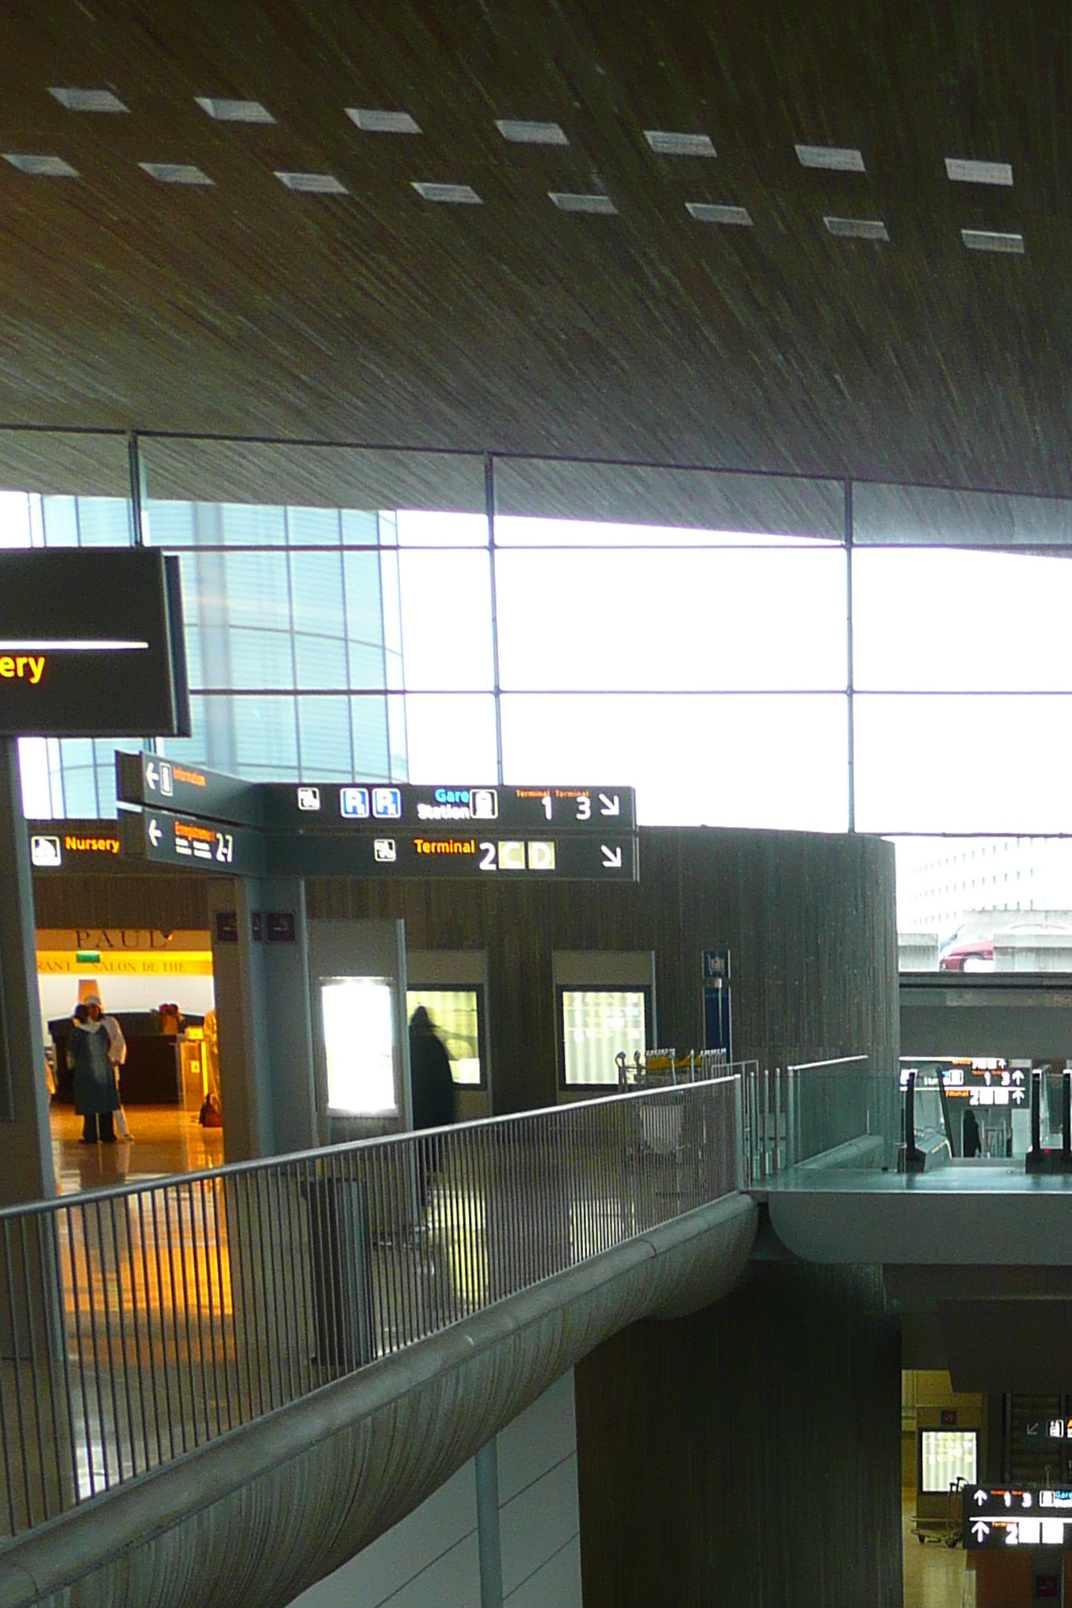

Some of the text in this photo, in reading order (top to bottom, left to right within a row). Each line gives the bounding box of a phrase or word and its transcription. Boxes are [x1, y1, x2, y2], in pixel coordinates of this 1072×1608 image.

[435, 788, 470, 803] Gare
[515, 789, 550, 798] Terminal
[555, 789, 589, 798] Terminal
[417, 803, 470, 820] Station
[541, 795, 552, 821] 1
[576, 797, 591, 821] 3
[65, 836, 121, 854] Nursery
[216, 833, 234, 863] 2-7
[414, 839, 476, 854] Terminal
[478, 841, 498, 871] 2
[76, 930, 167, 948] PAUL
[143, 962, 155, 973] DE
[1004, 1491, 1012, 1508] 1
[1005, 1523, 1019, 1545] 2
